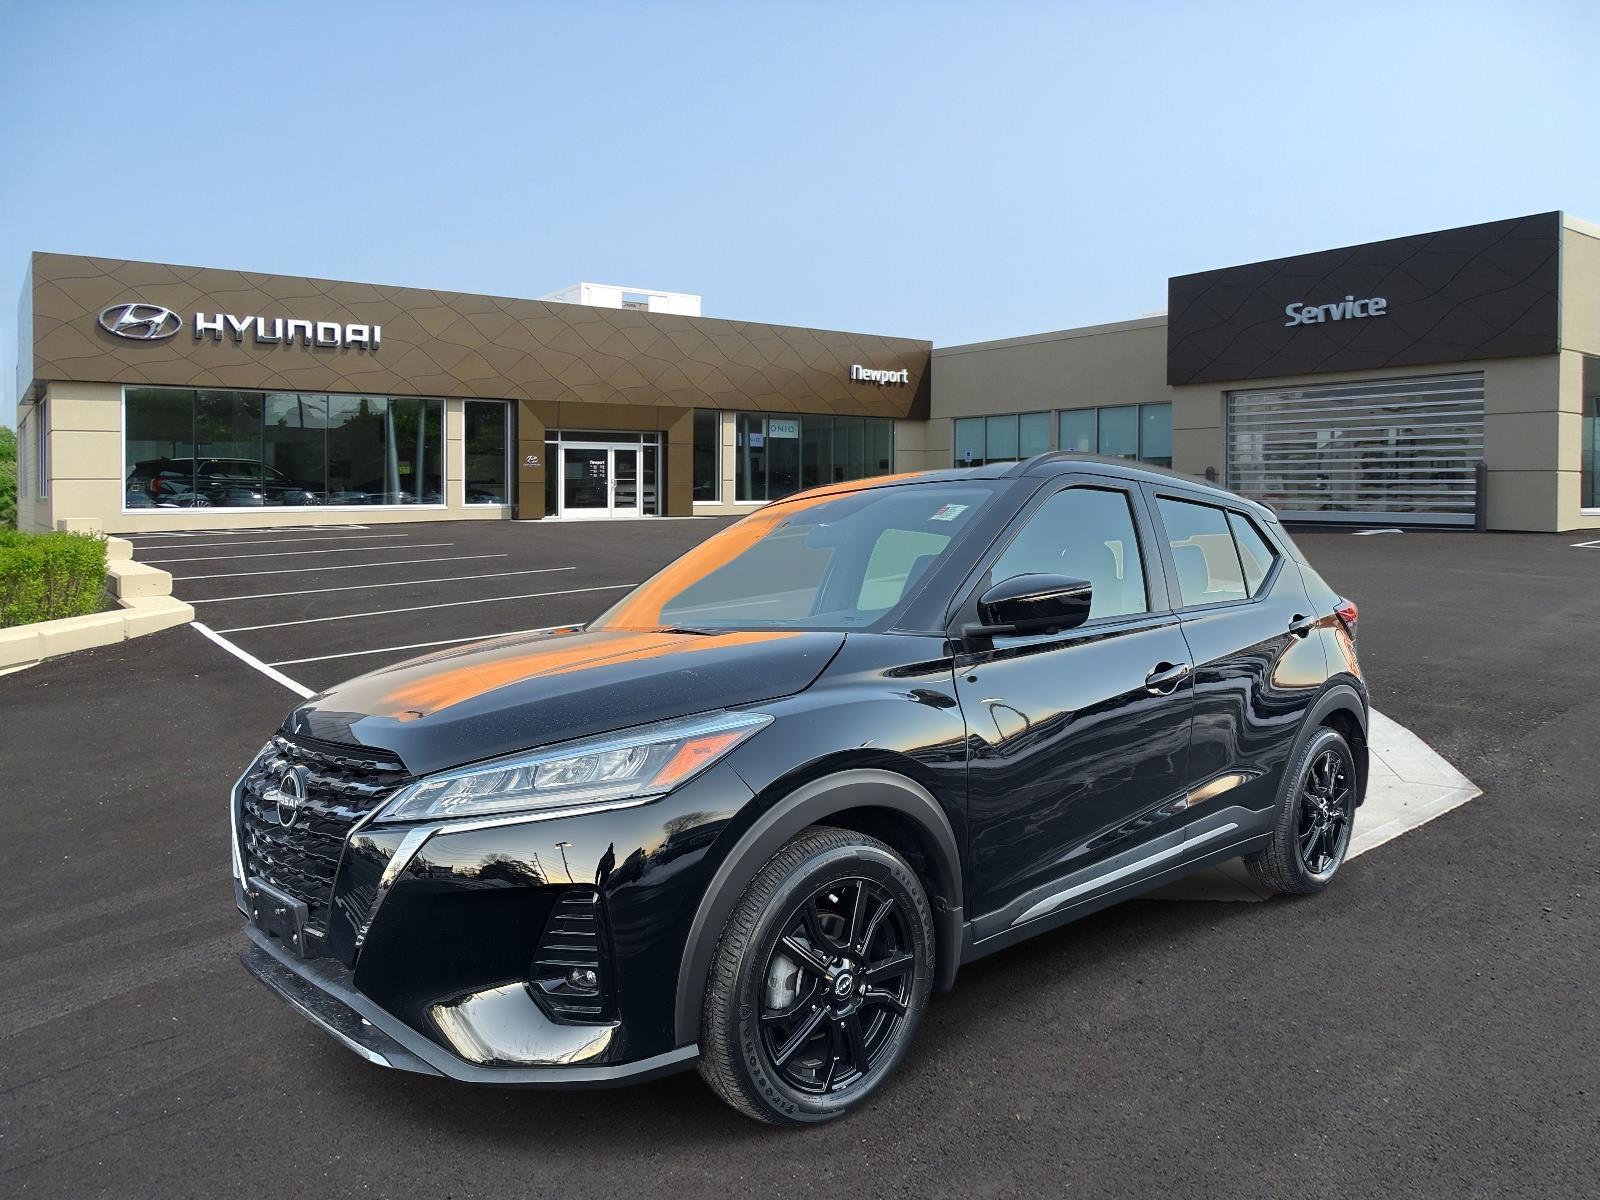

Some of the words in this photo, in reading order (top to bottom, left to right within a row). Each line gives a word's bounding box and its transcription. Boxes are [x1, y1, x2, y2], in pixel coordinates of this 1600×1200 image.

[1284, 295, 1387, 327] Service
[194, 312, 381, 350] HYUNDAI
[851, 364, 909, 384] Newport
[277, 791, 299, 808] SSAN
